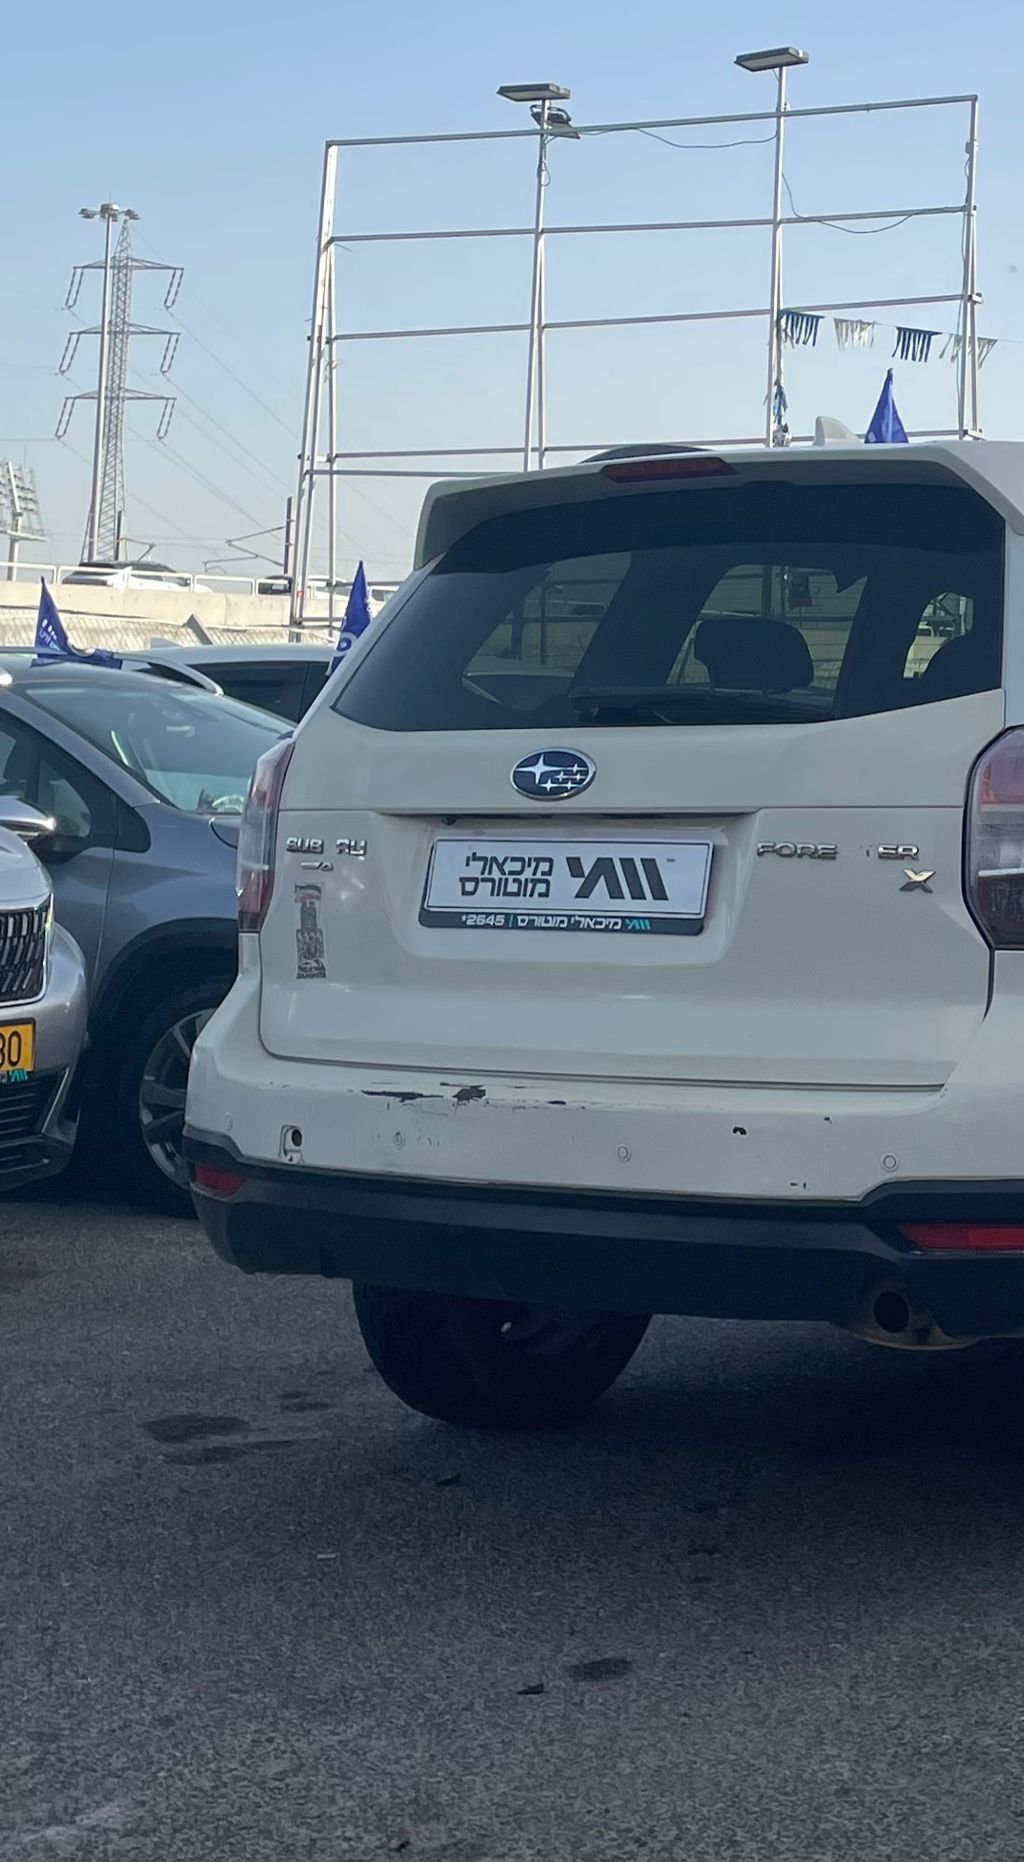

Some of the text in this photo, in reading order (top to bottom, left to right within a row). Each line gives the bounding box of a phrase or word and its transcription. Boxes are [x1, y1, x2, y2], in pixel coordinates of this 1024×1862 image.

[465, 852, 554, 876] מיכאלי
[459, 877, 551, 898] מוטורס
[517, 915, 568, 928] מוטורס
[571, 915, 622, 930] מיכאלי
